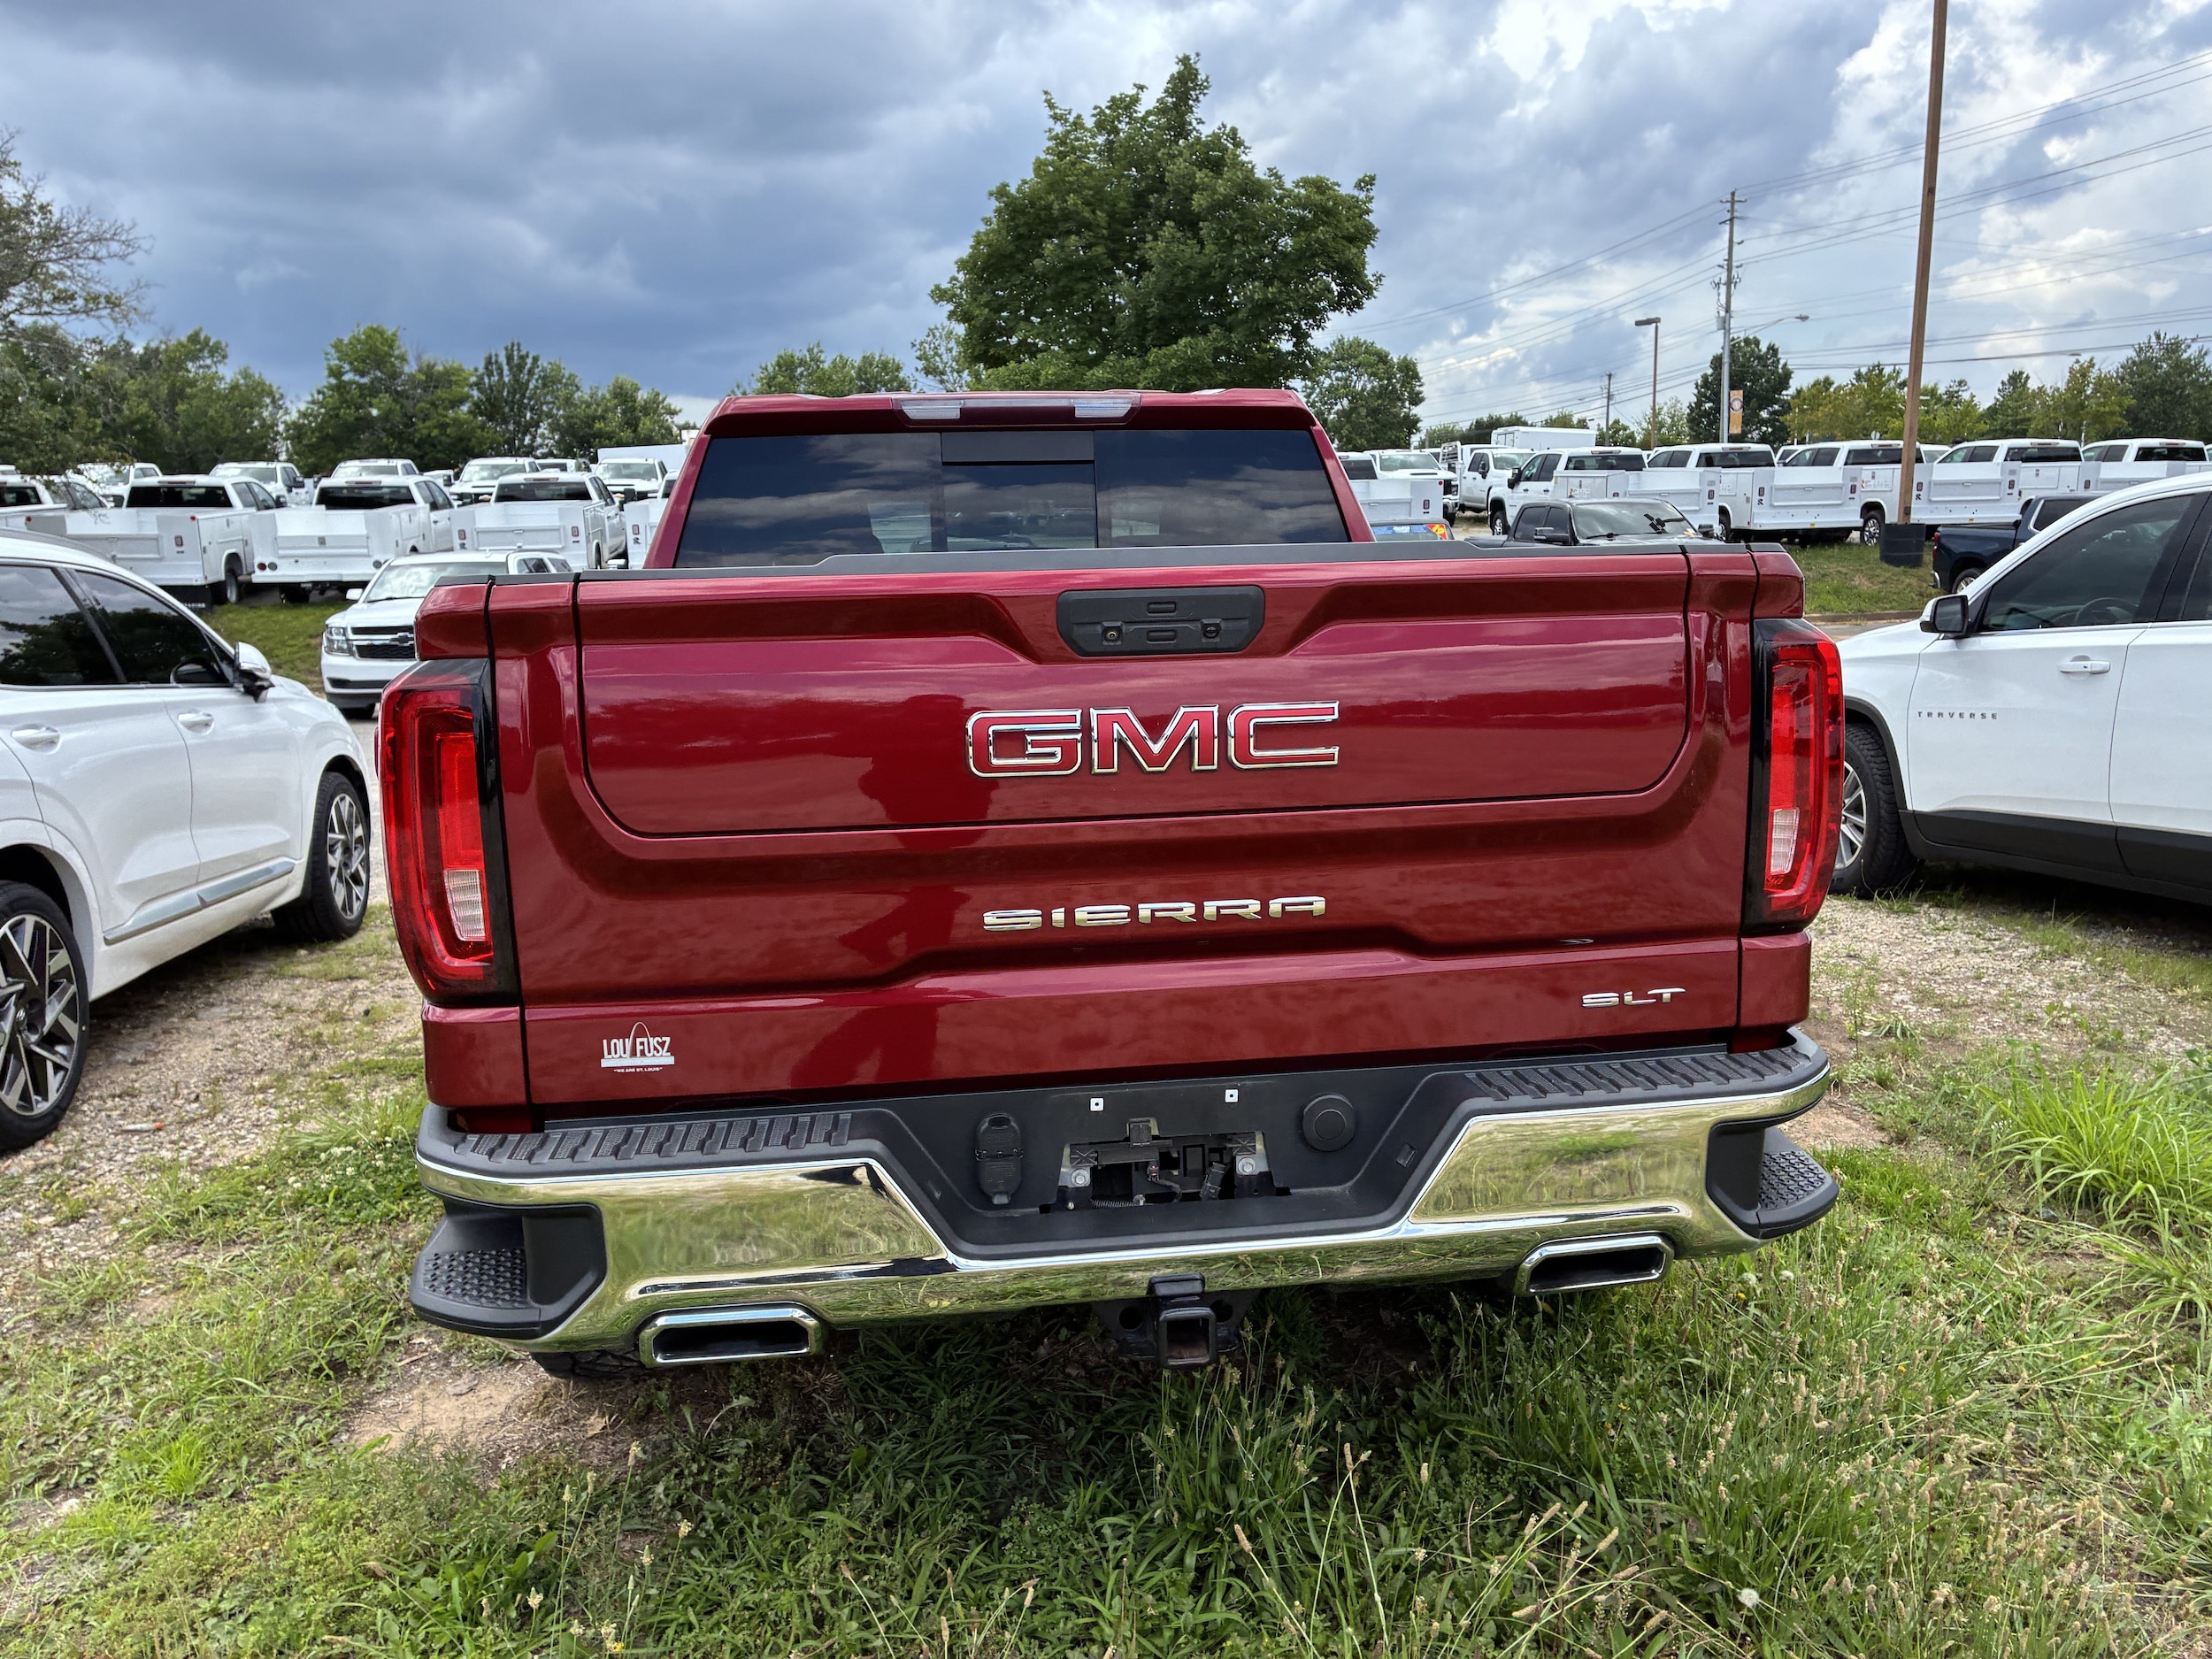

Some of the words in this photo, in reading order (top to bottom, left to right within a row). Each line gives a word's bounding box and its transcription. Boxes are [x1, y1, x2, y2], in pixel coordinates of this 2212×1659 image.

[1917, 711, 1998, 720] TRAVERSE
[965, 700, 1340, 778] GMC
[982, 895, 1326, 932] SIERRA
[1582, 987, 1686, 1008] SLT
[603, 1038, 630, 1059] LOU
[636, 1037, 671, 1057] FUSZ
